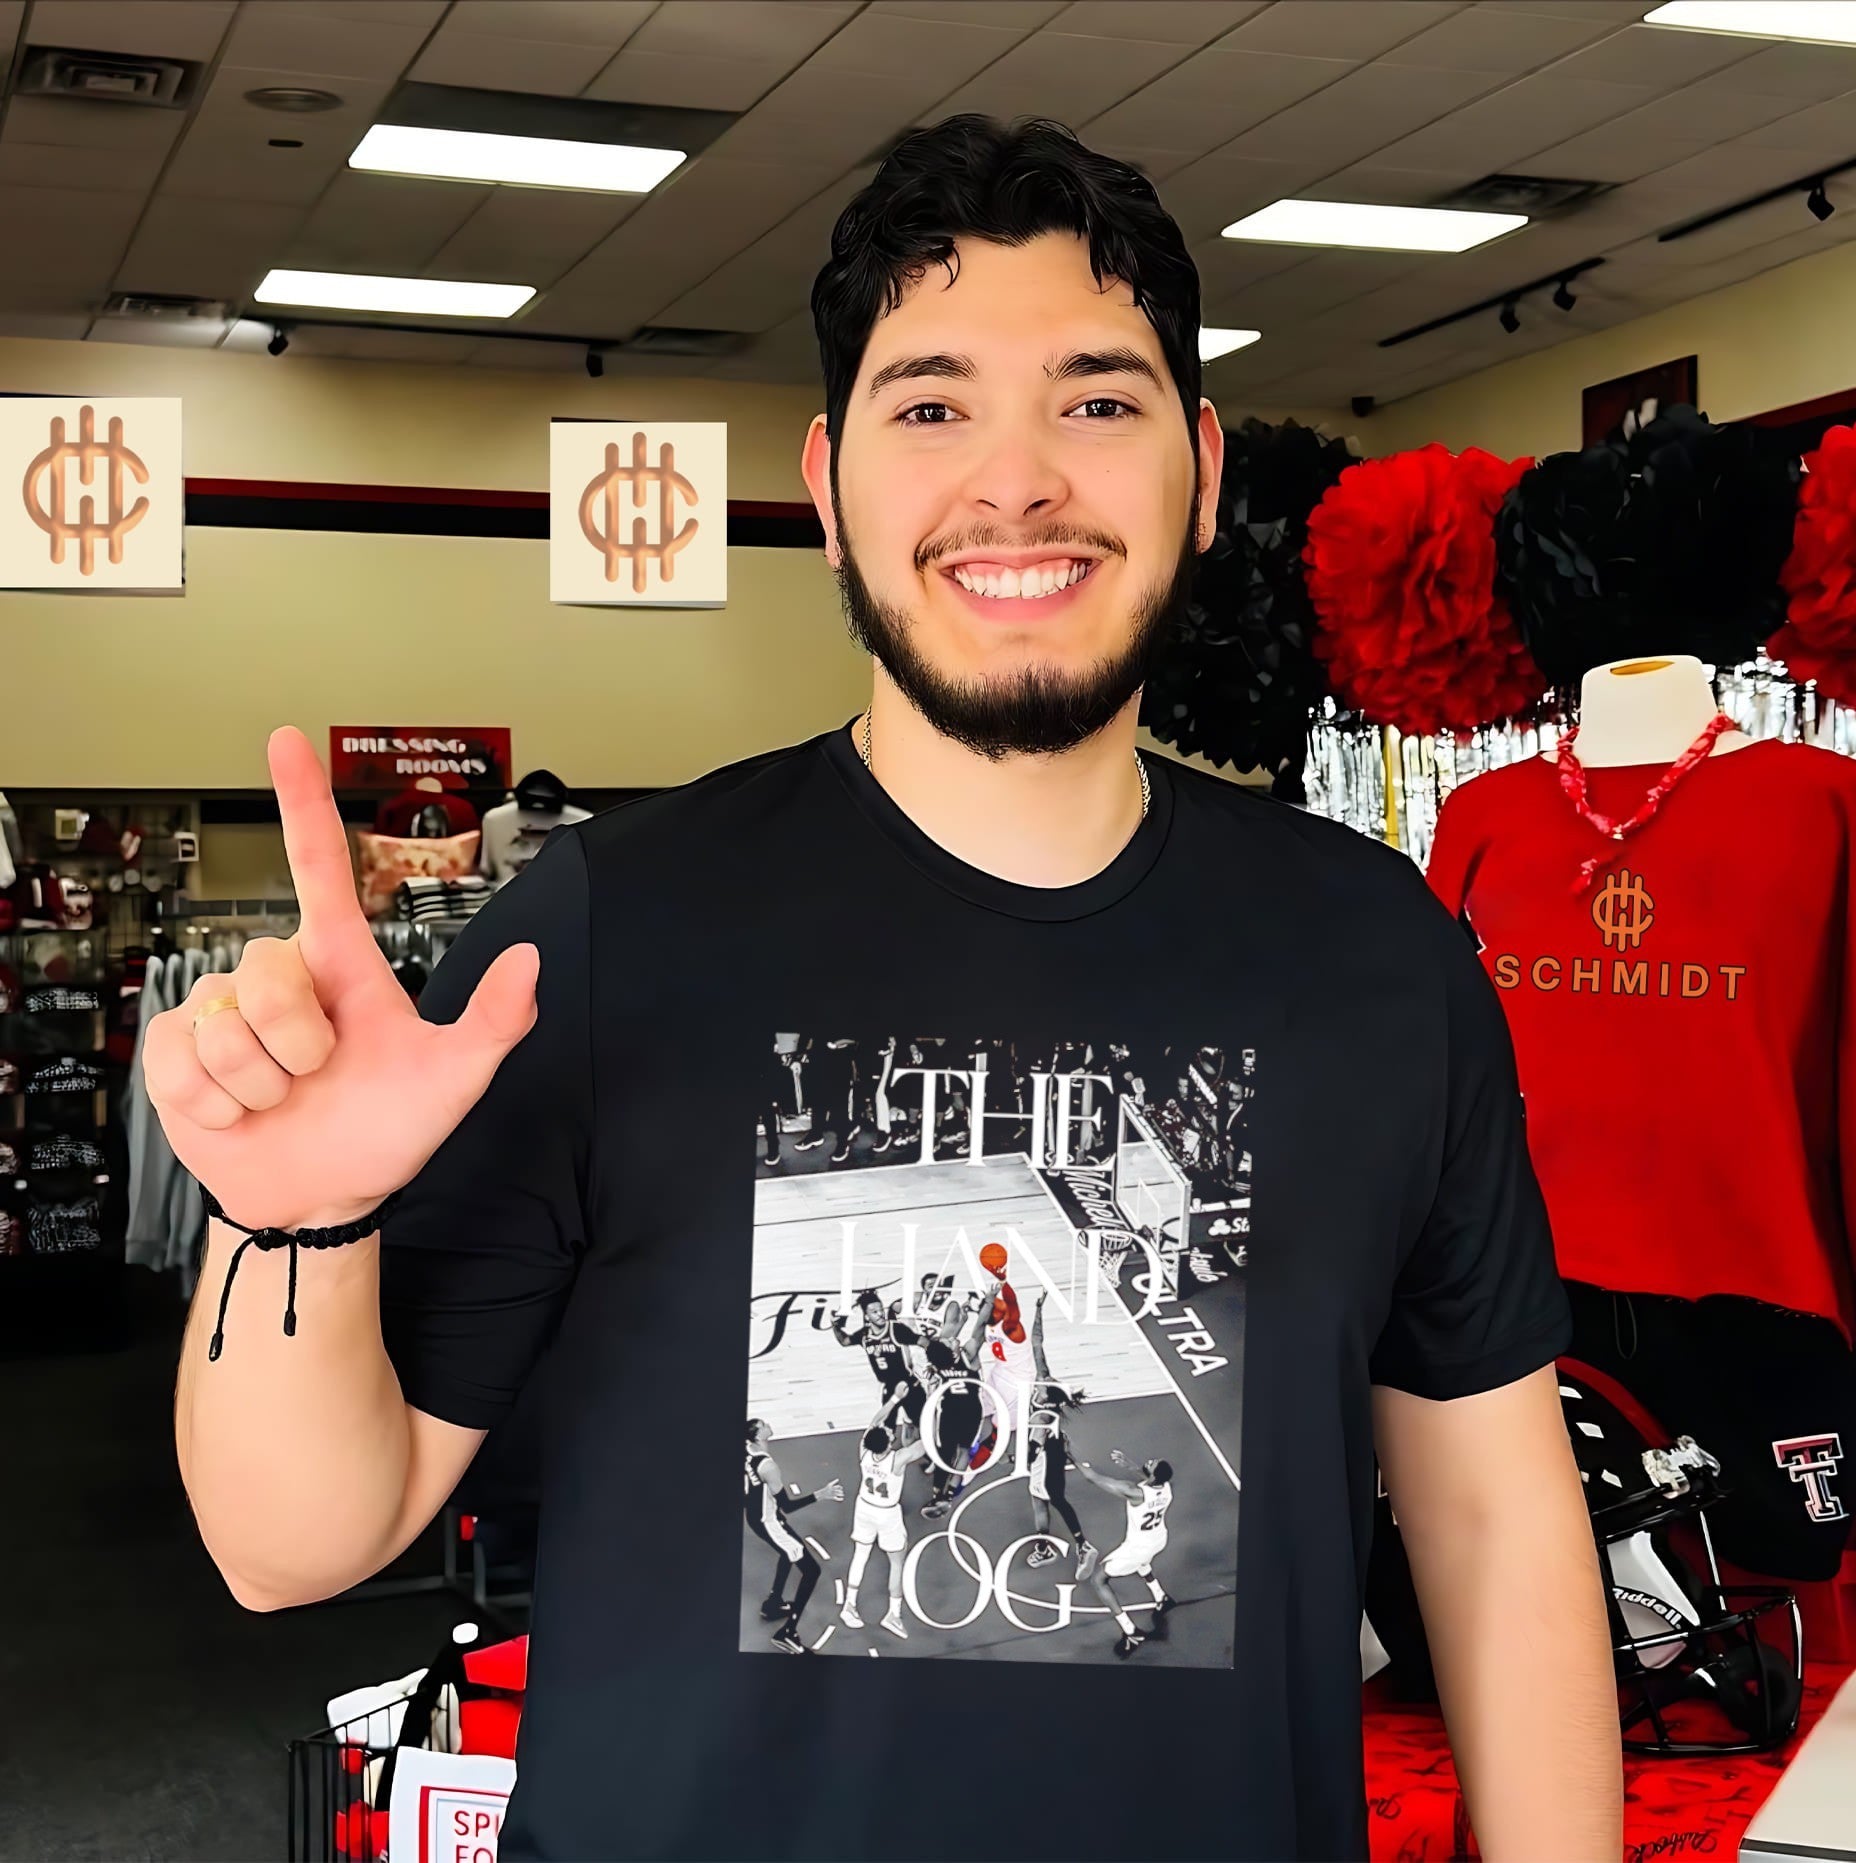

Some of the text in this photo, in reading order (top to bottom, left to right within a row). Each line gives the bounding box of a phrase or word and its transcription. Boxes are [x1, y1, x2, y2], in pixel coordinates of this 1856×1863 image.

[342, 737, 467, 754] DRESSING
[396, 758, 487, 775] ROOMS
[1494, 954, 1747, 1000] SCHMIDT
[890, 1067, 1117, 1170] THE
[838, 1220, 1164, 1325] HAND
[919, 1378, 1073, 1480] OF
[1141, 1507, 1165, 1531] 25
[901, 1530, 1078, 1634] OG
